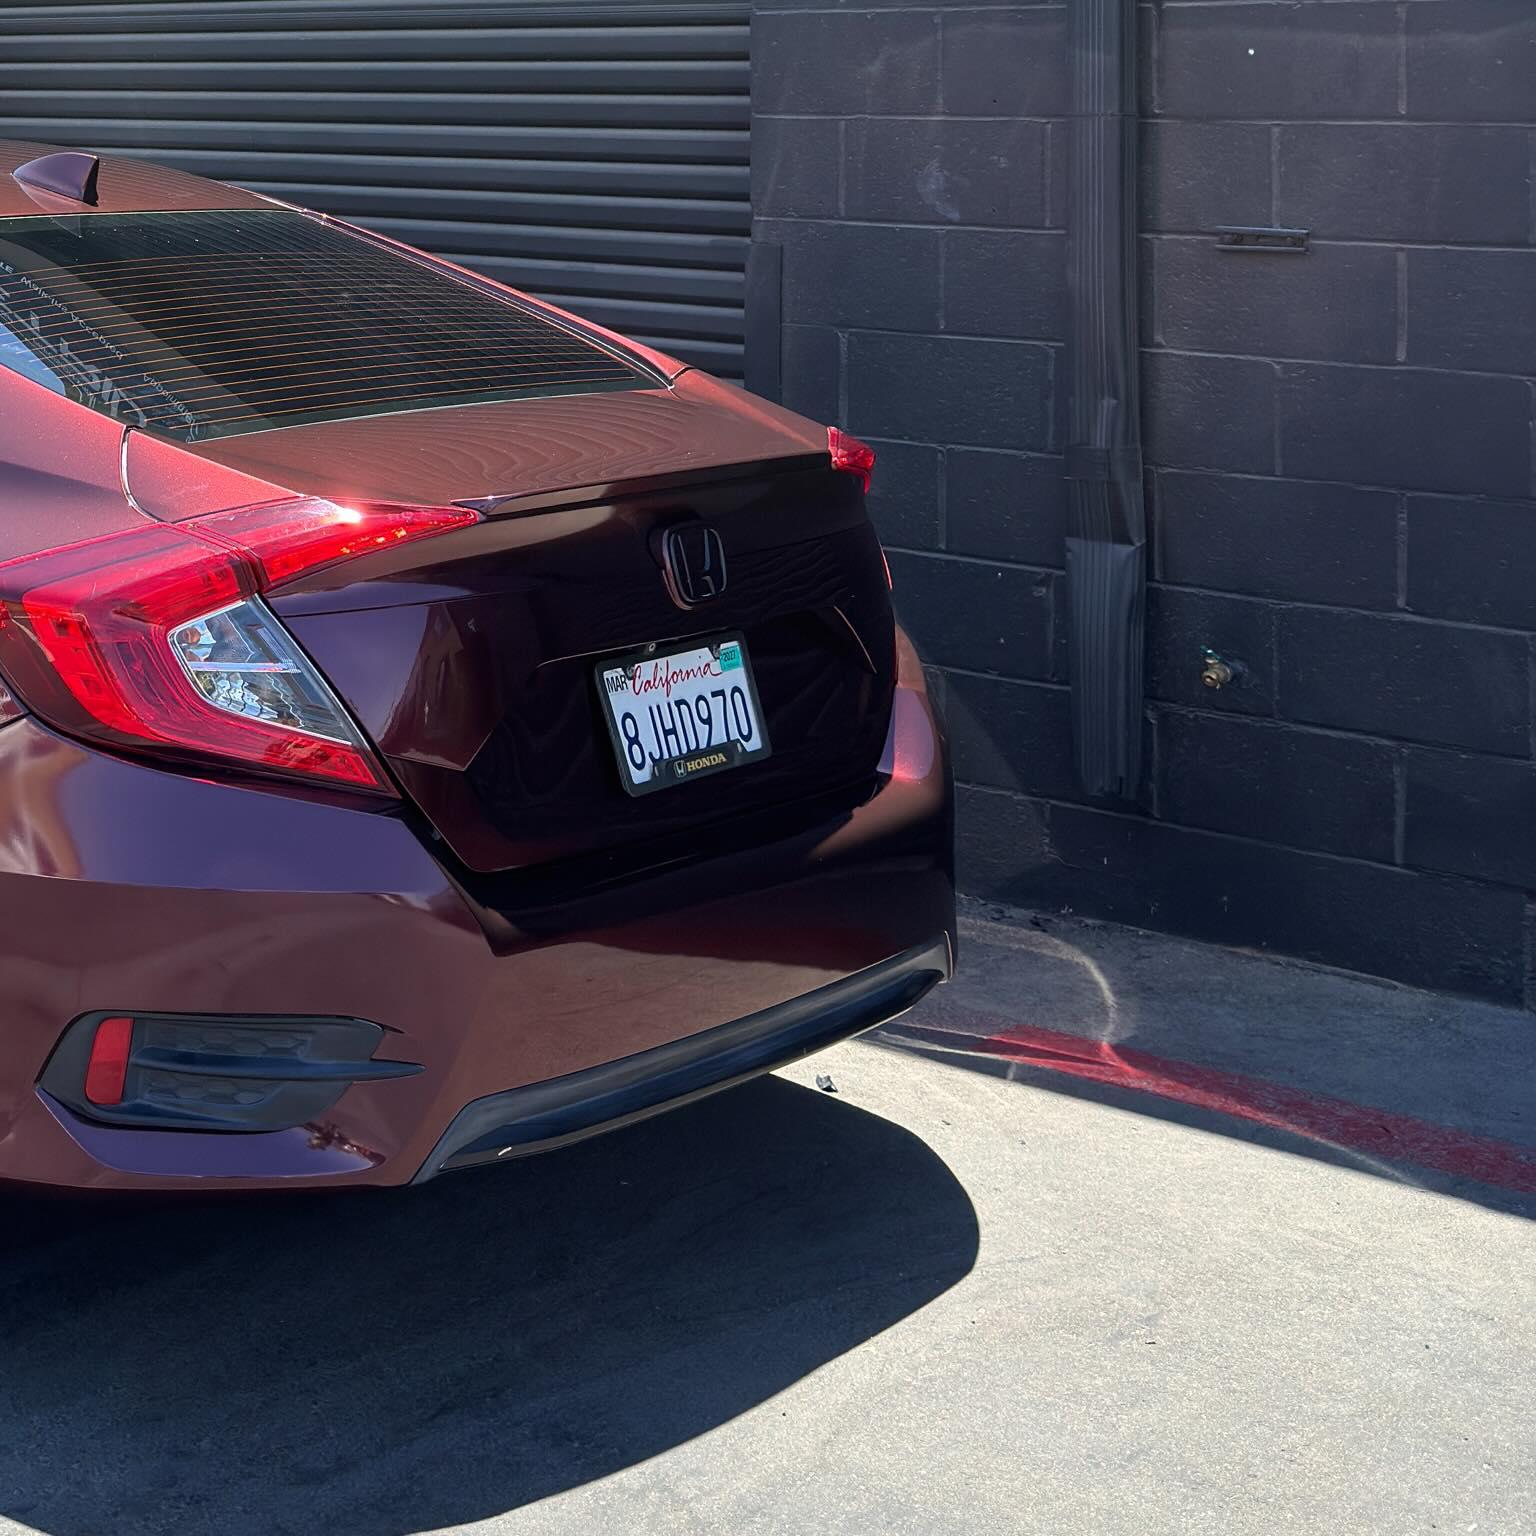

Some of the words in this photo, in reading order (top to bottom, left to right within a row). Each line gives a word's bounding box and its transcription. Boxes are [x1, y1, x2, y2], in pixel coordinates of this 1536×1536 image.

[606, 674, 629, 693] MAR
[631, 660, 723, 698] California
[621, 685, 754, 772] 8JHD970
[686, 753, 727, 772] HONDA
